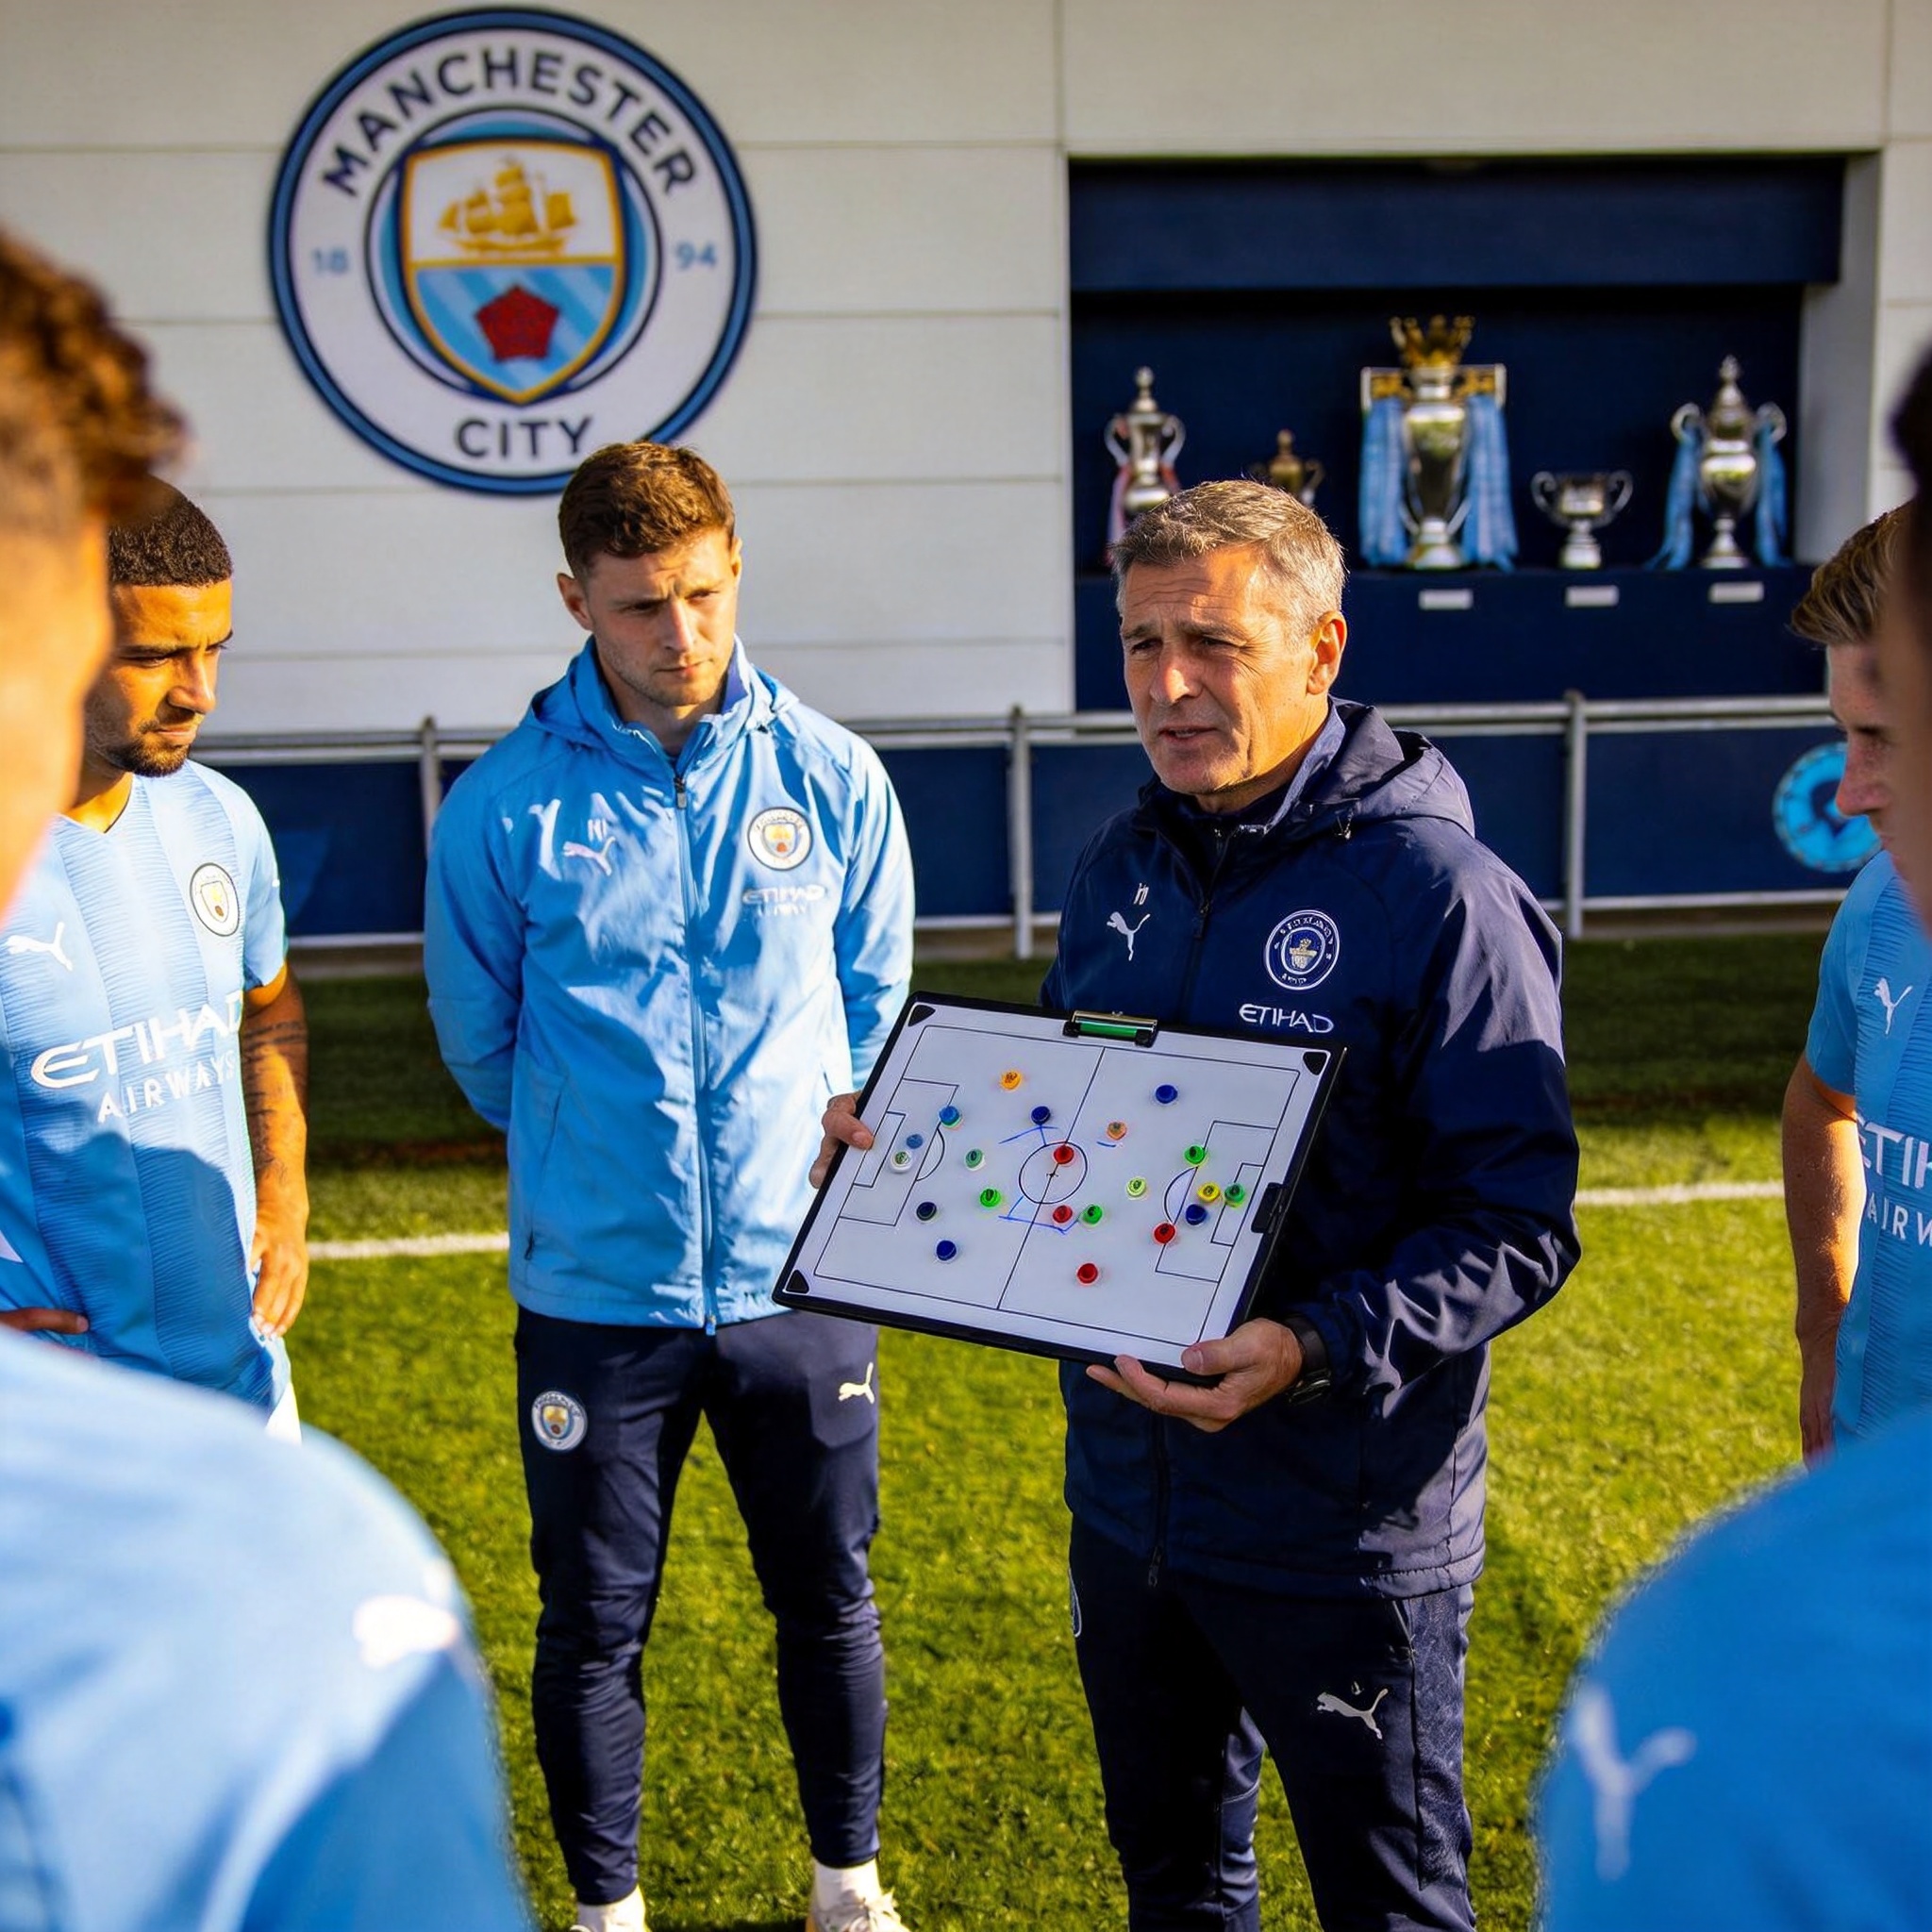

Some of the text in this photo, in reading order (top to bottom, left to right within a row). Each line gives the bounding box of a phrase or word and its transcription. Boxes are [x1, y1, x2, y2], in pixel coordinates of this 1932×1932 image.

[323, 46, 696, 196] MANCHESTER
[674, 242, 717, 271] 94
[455, 416, 591, 459] CITY
[1239, 1003, 1334, 1034] ETIHAD
[98, 1049, 236, 1124] AIRWAYS
